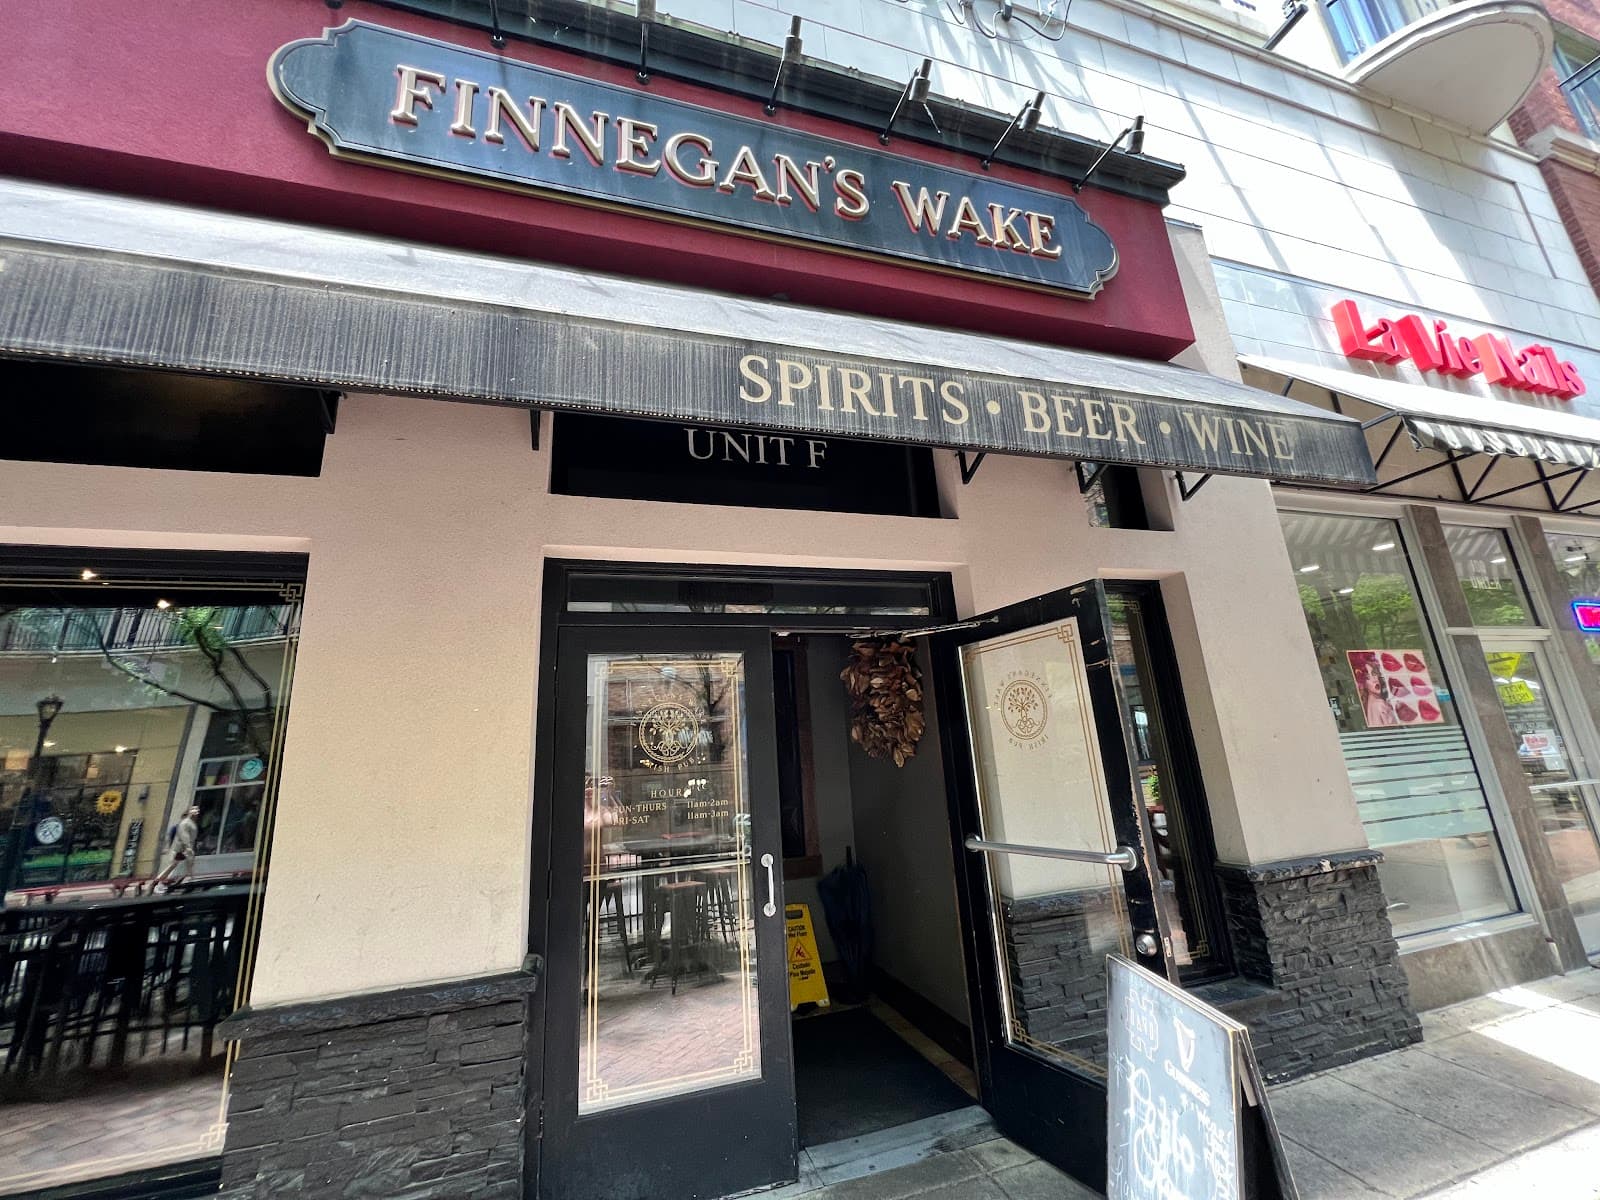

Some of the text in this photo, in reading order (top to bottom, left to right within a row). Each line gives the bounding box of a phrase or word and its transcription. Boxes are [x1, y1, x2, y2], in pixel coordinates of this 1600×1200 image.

[389, 63, 1062, 260] FINNEGAN'S WAKE
[1331, 299, 1586, 400] La Vie Nails
[683, 428, 828, 468] UNIT F
[739, 355, 1294, 460] SPIRITS BEER WINE
[651, 788, 691, 798] HOUR
